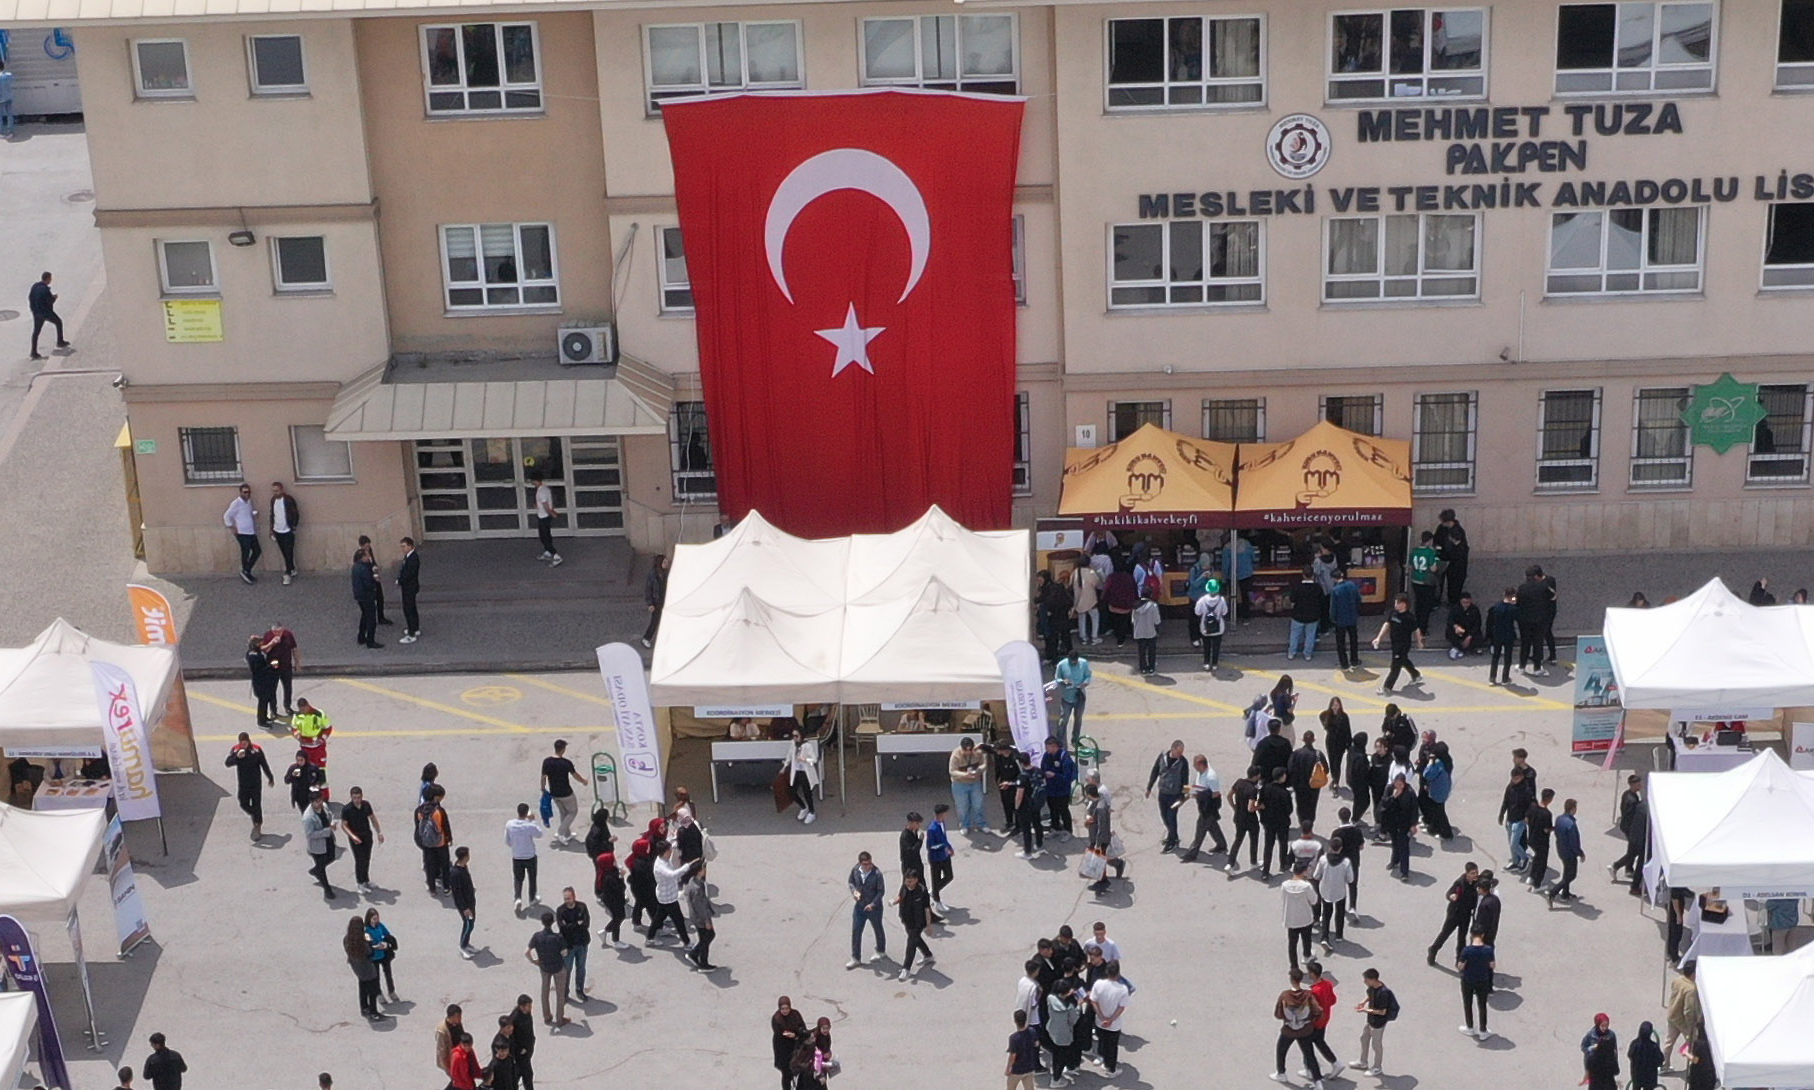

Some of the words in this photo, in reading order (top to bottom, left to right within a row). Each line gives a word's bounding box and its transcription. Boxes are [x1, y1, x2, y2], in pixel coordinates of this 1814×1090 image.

[1357, 106, 1551, 143] MEHMET
[1563, 104, 1685, 137] TUZA
[1445, 139, 1588, 176] PAKPEN
[1138, 183, 1316, 219] MESLEKİ
[1328, 186, 1381, 213] VE
[1387, 175, 1543, 212] TEKNİK
[1551, 176, 1739, 207] ANADOLU
[1081, 429, 1091, 440] 10
